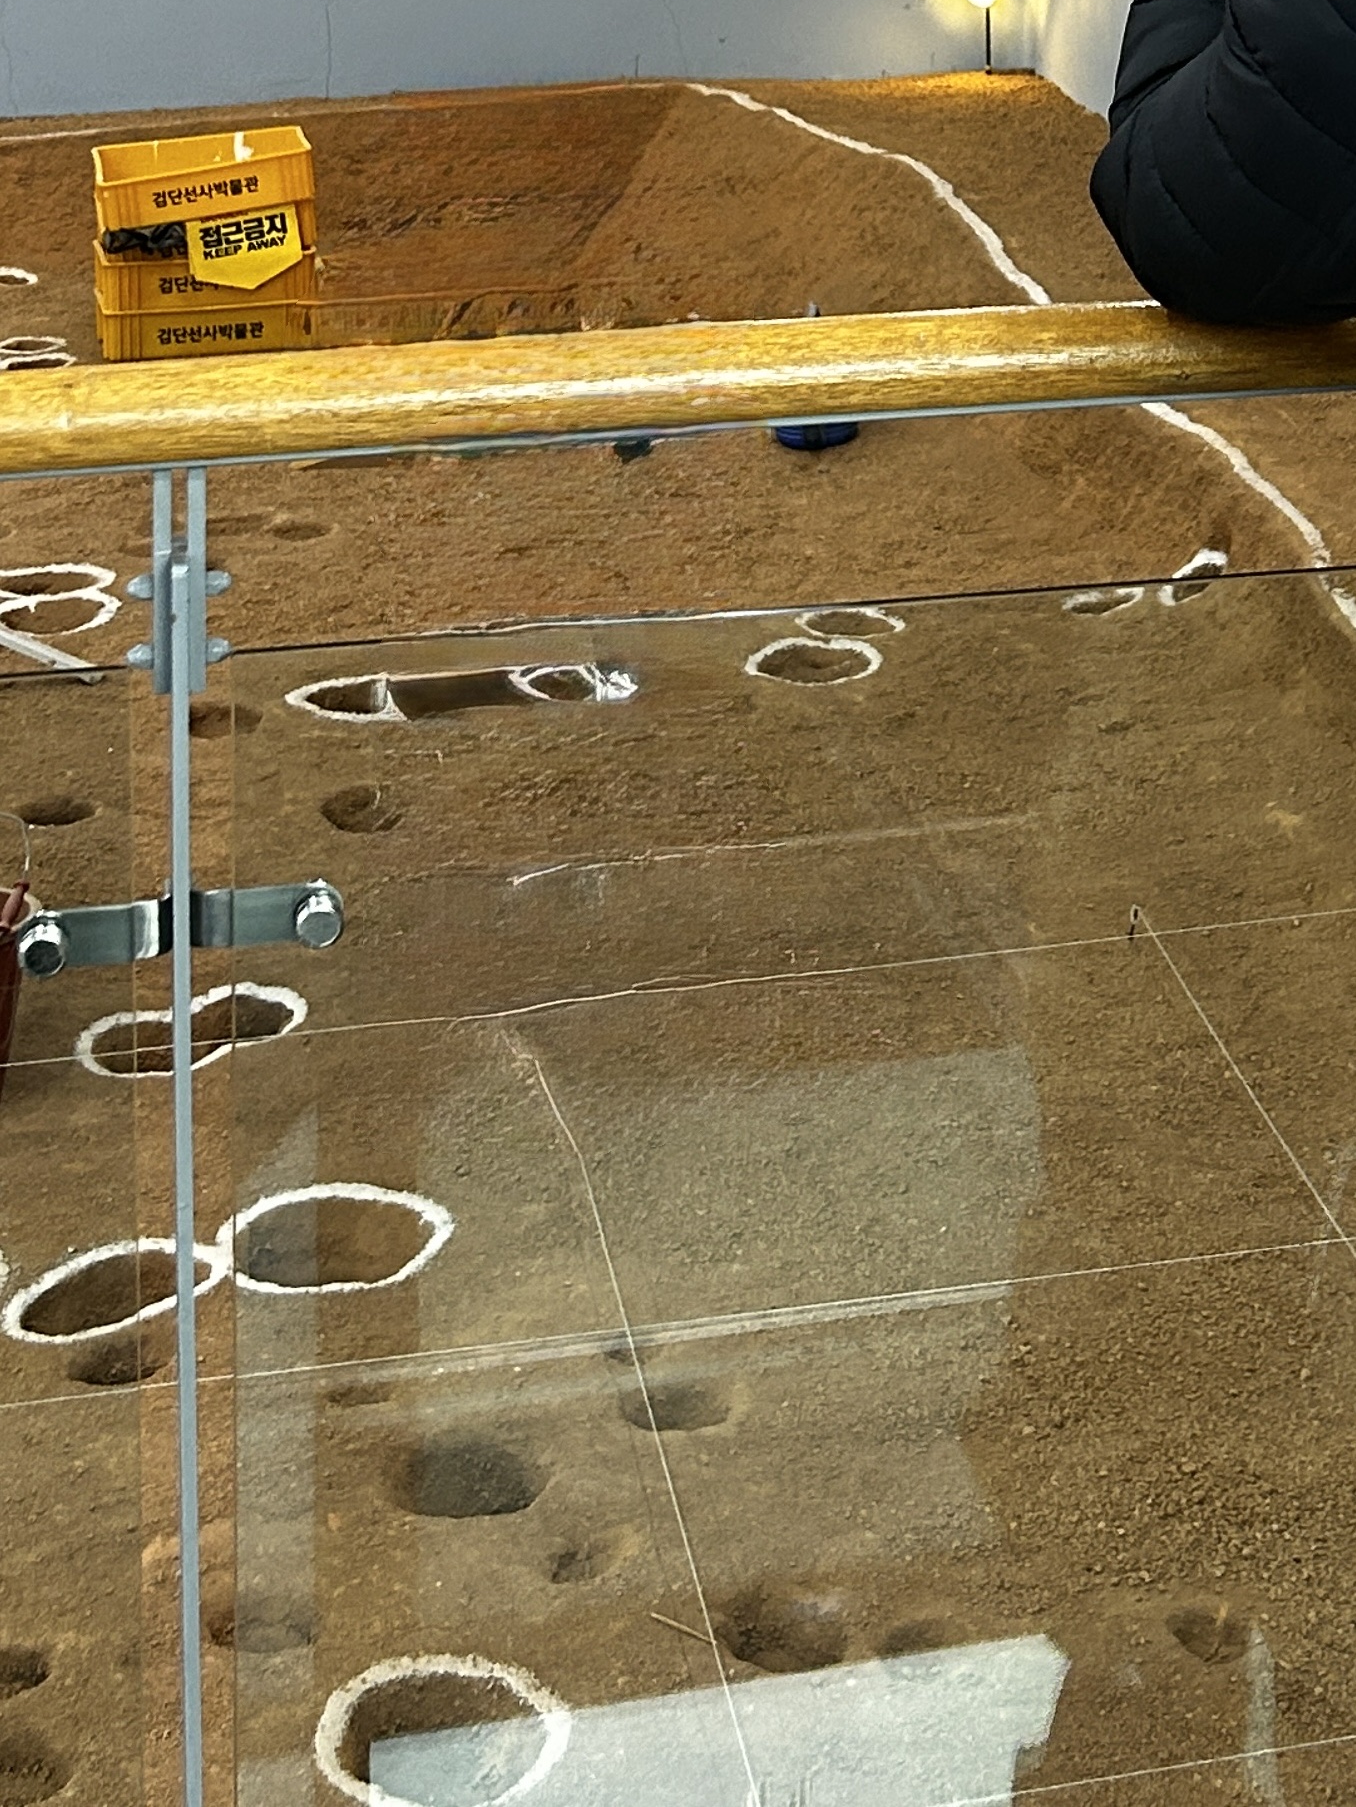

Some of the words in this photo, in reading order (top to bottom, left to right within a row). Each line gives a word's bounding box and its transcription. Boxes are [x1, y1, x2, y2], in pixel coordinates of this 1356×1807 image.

[152, 175, 259, 208] 검단선사박물관
[199, 212, 288, 249] 접근금지
[203, 244, 243, 260] KEEP
[247, 235, 286, 252] AWAY
[157, 321, 265, 345] 검단선사박물관
